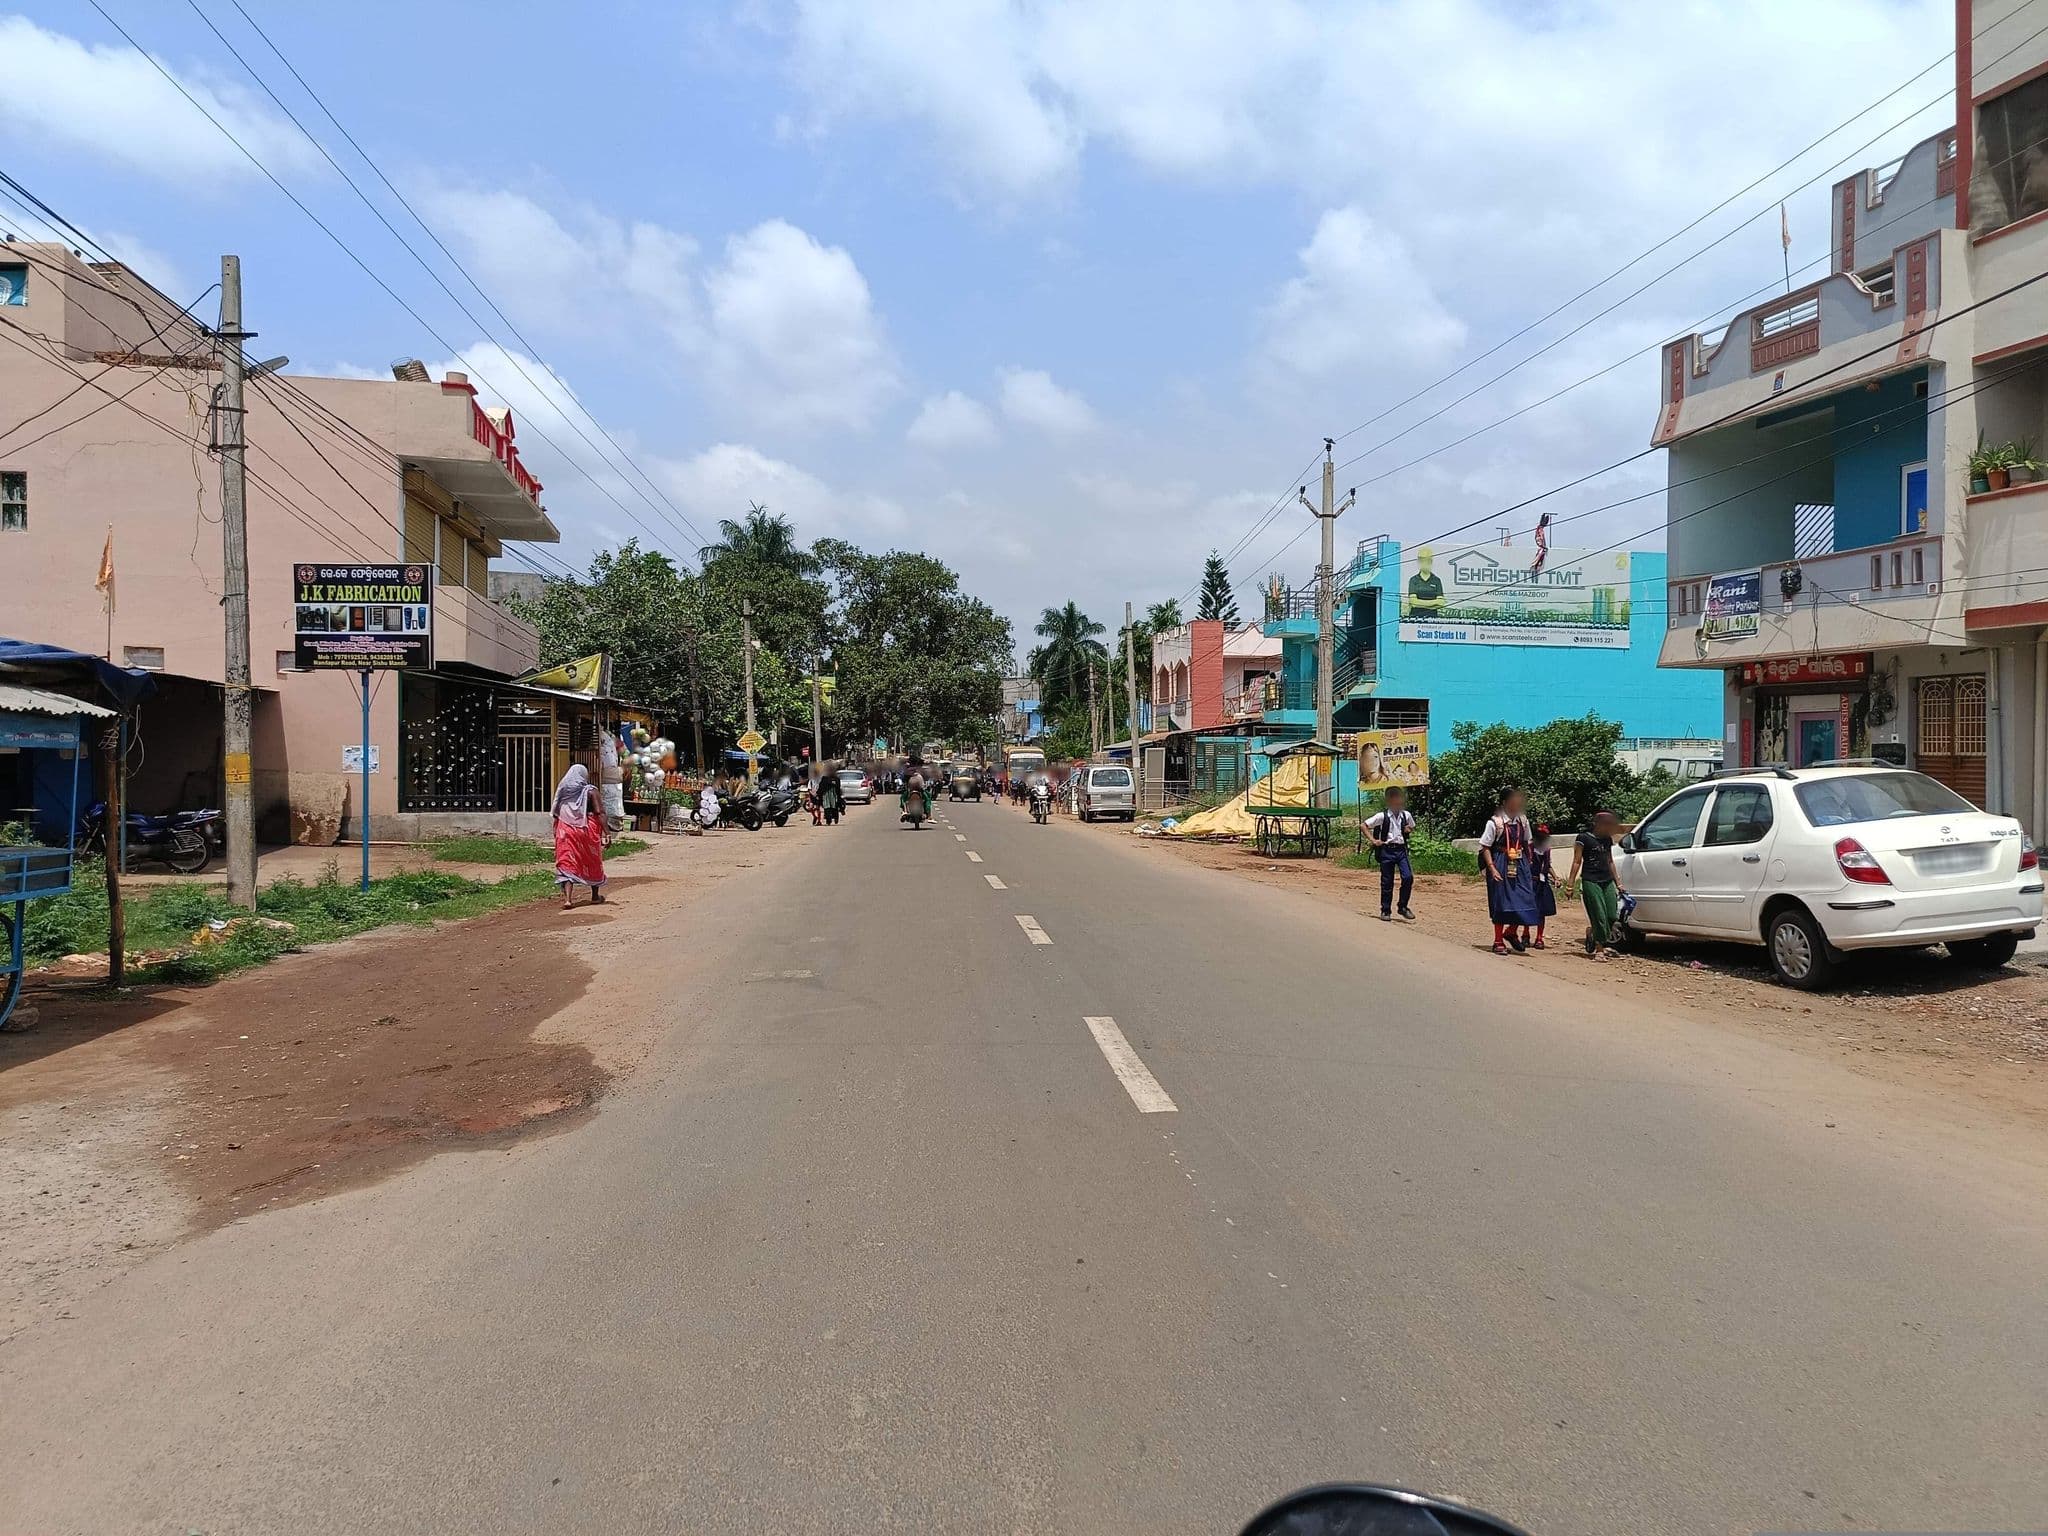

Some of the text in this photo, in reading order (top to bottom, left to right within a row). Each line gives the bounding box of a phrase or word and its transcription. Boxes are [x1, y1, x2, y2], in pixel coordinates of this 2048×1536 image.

[1459, 567, 1583, 586] SHRISHTI TMT
[301, 585, 422, 601] J.K FABRICATION
[1417, 630, 1466, 640] Scan Steels Ltd
[1841, 694, 1849, 722] ADIES
